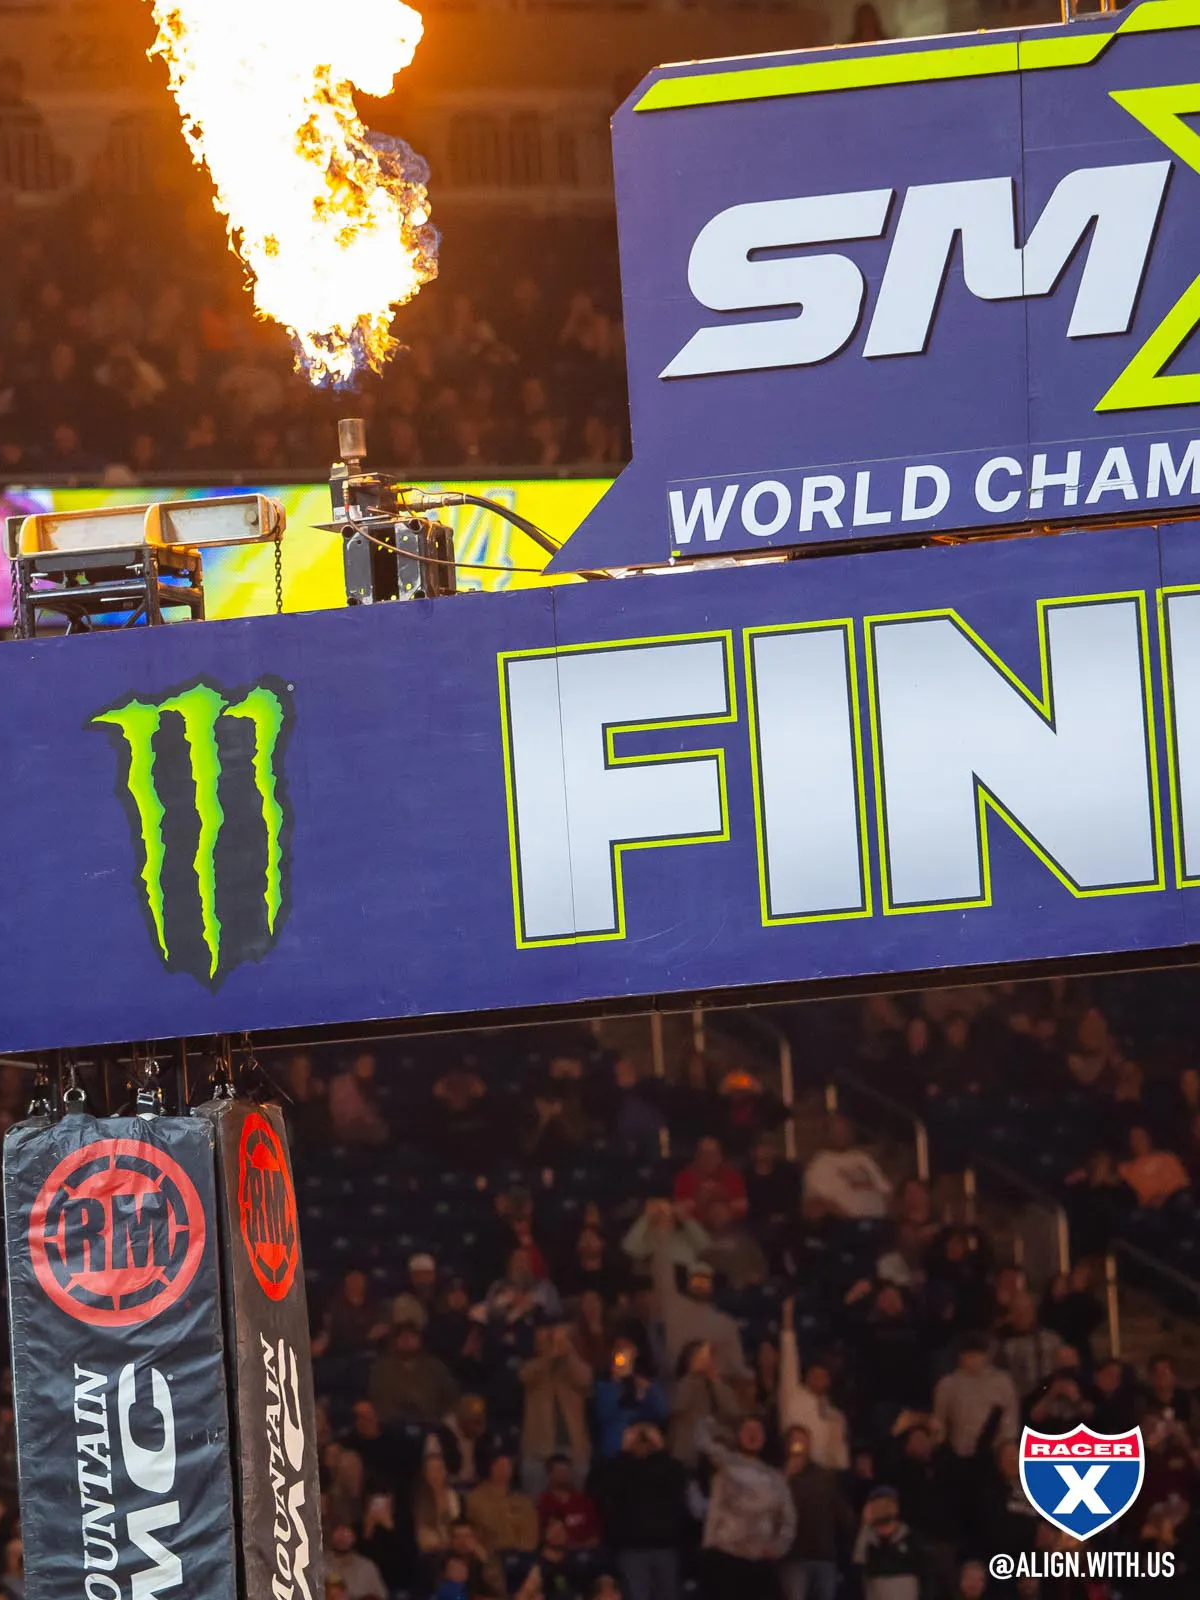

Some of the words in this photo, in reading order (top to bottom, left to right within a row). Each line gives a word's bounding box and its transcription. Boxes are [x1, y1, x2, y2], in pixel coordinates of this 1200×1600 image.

[668, 464, 950, 544] WORLD
[974, 439, 1200, 513] CHAM
[62, 1193, 174, 1274] RM
[246, 1166, 294, 1246] RM
